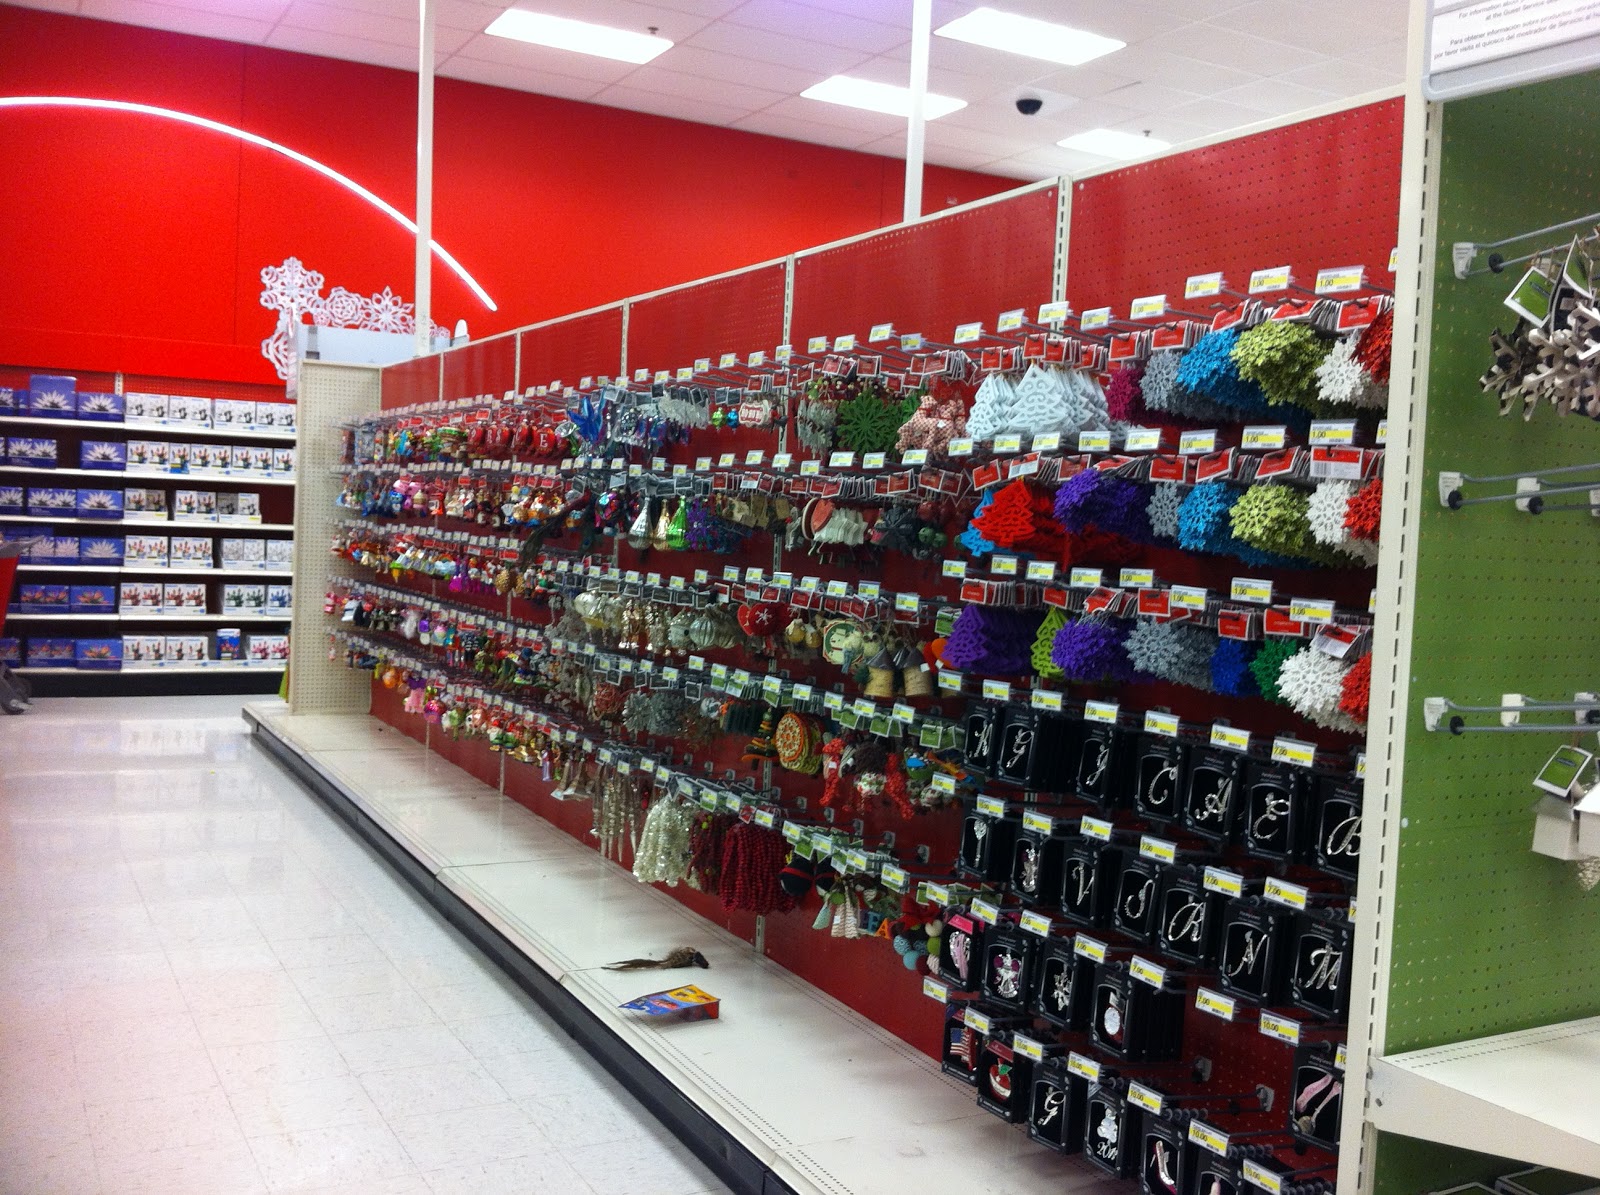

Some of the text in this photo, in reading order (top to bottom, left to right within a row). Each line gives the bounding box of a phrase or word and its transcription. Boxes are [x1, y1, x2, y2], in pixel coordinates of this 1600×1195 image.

[1450, 38, 1463, 46] Para
[1464, 32, 1486, 42] obtener
[1434, 52, 1444, 61] por
[1445, 48, 1459, 56] favor
[1252, 280, 1265, 288] 1.00
[1320, 279, 1334, 287] 1.00
[1188, 285, 1200, 293] 1.00
[1246, 435, 1259, 443] 1.00
[1312, 430, 1326, 438] 1.00
[1234, 588, 1248, 596] 1.00
[1292, 607, 1306, 616] 1.00
[1146, 720, 1158, 728] 7.00
[1213, 732, 1227, 741] 7.00
[1273, 747, 1288, 757] 7.00
[1148, 762, 1179, 805] C
[1194, 777, 1232, 822] A
[1253, 798, 1290, 840] E
[1141, 843, 1154, 852] 7.00
[1205, 876, 1219, 887] 7.00
[1267, 885, 1281, 897] 7.00
[1132, 964, 1144, 975] 7.00
[1304, 947, 1342, 990] M
[1198, 996, 1210, 1006] 7.00
[1262, 1019, 1279, 1033] 10.00
[1190, 1129, 1208, 1142] 10.00
